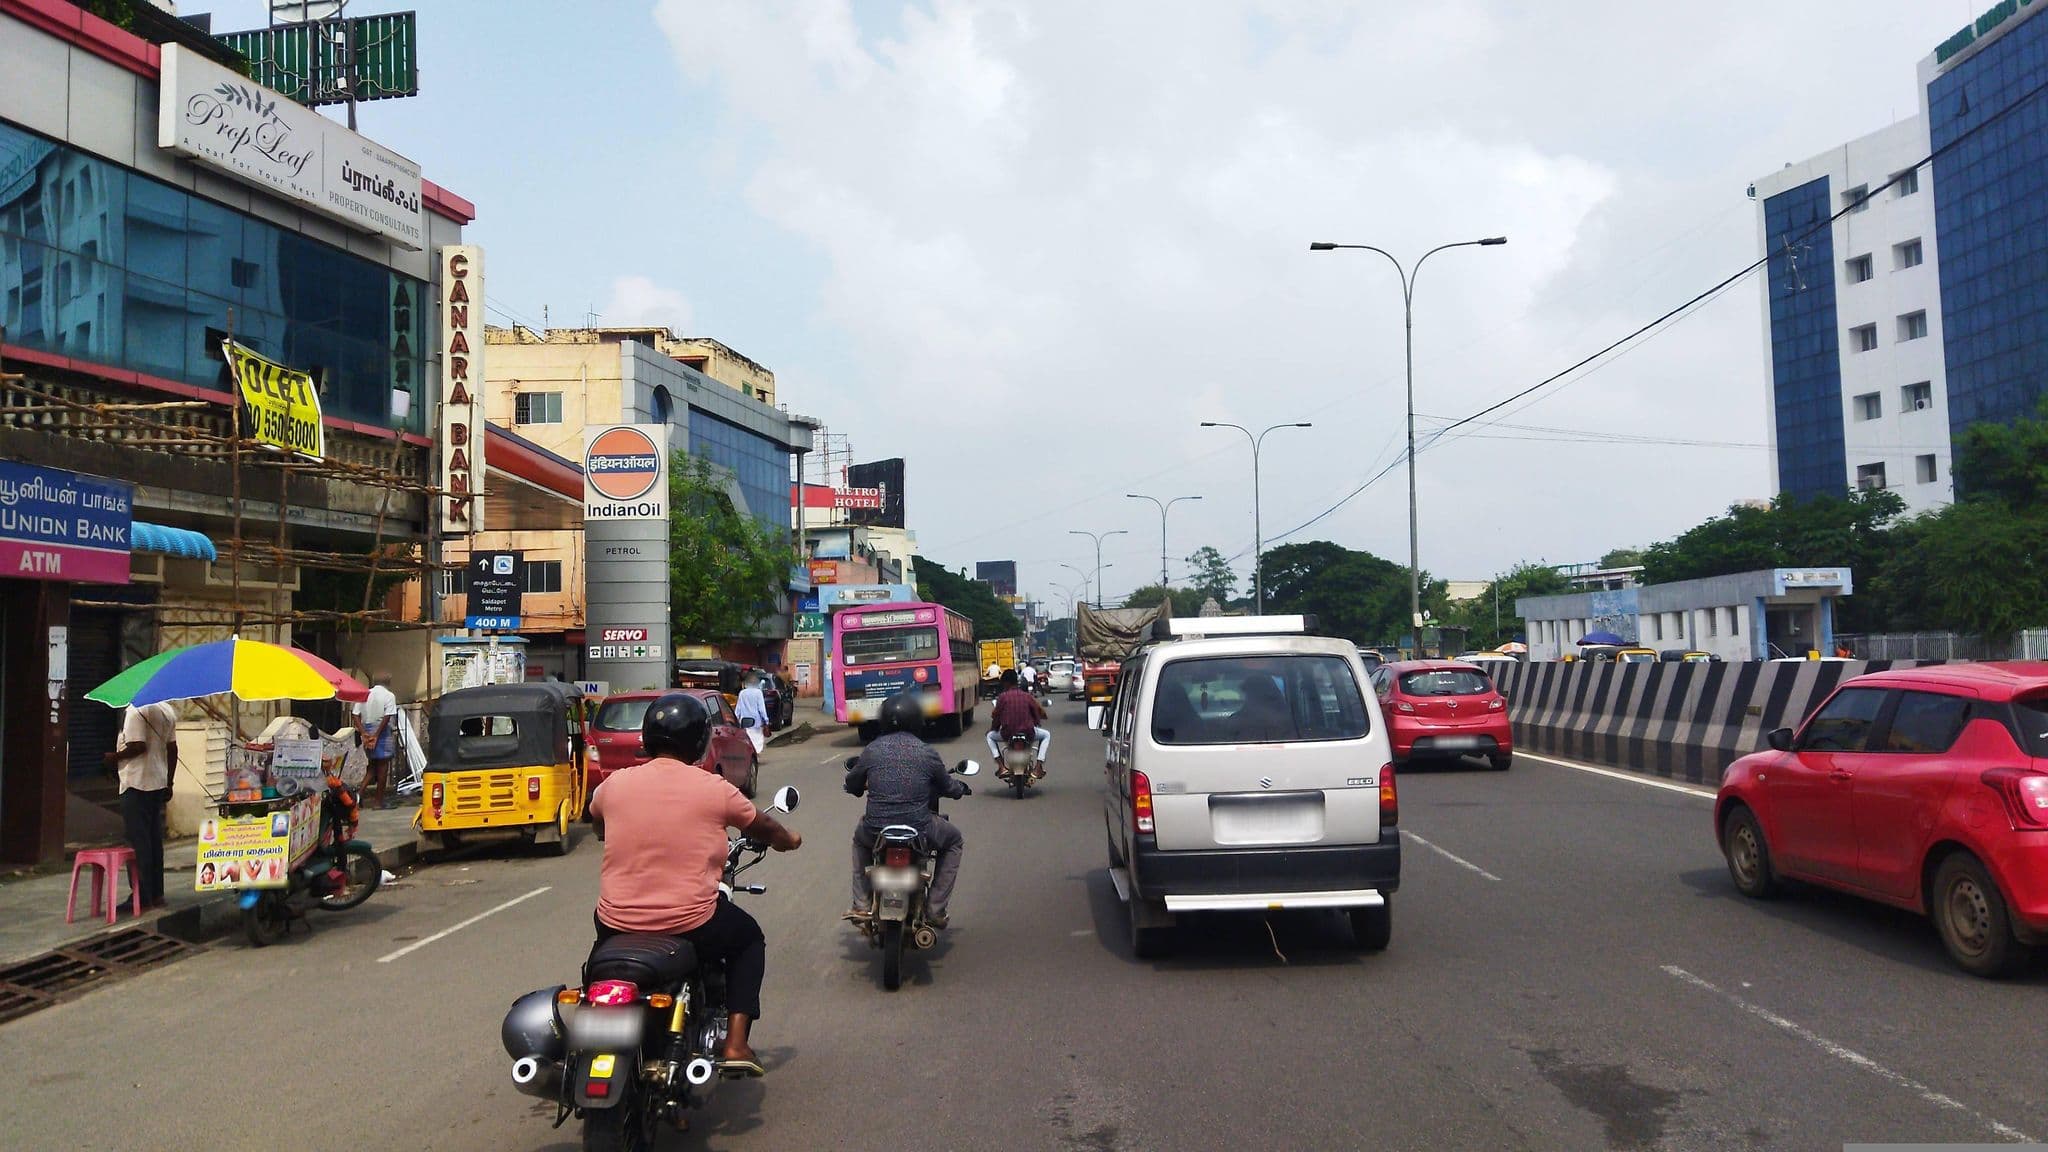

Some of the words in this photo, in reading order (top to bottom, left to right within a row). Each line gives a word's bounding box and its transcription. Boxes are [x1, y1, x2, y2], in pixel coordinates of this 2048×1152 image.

[329, 190, 368, 217] PROPERTY
[369, 208, 419, 239] CONSULTANTS
[449, 254, 470, 405] CANARA
[590, 456, 655, 472] इंडियनऑयल
[449, 422, 468, 522] BANK
[0, 476, 77, 505] யூனியன்
[834, 487, 878, 496] METRO
[834, 498, 878, 507] HOTEL
[588, 503, 660, 517] IndianOil
[606, 547, 641, 555] PETROL
[19, 550, 61, 574] ATM
[475, 618, 497, 627] 400
[500, 618, 511, 627] M
[604, 630, 642, 640] SERVO
[585, 683, 598, 692] IN
